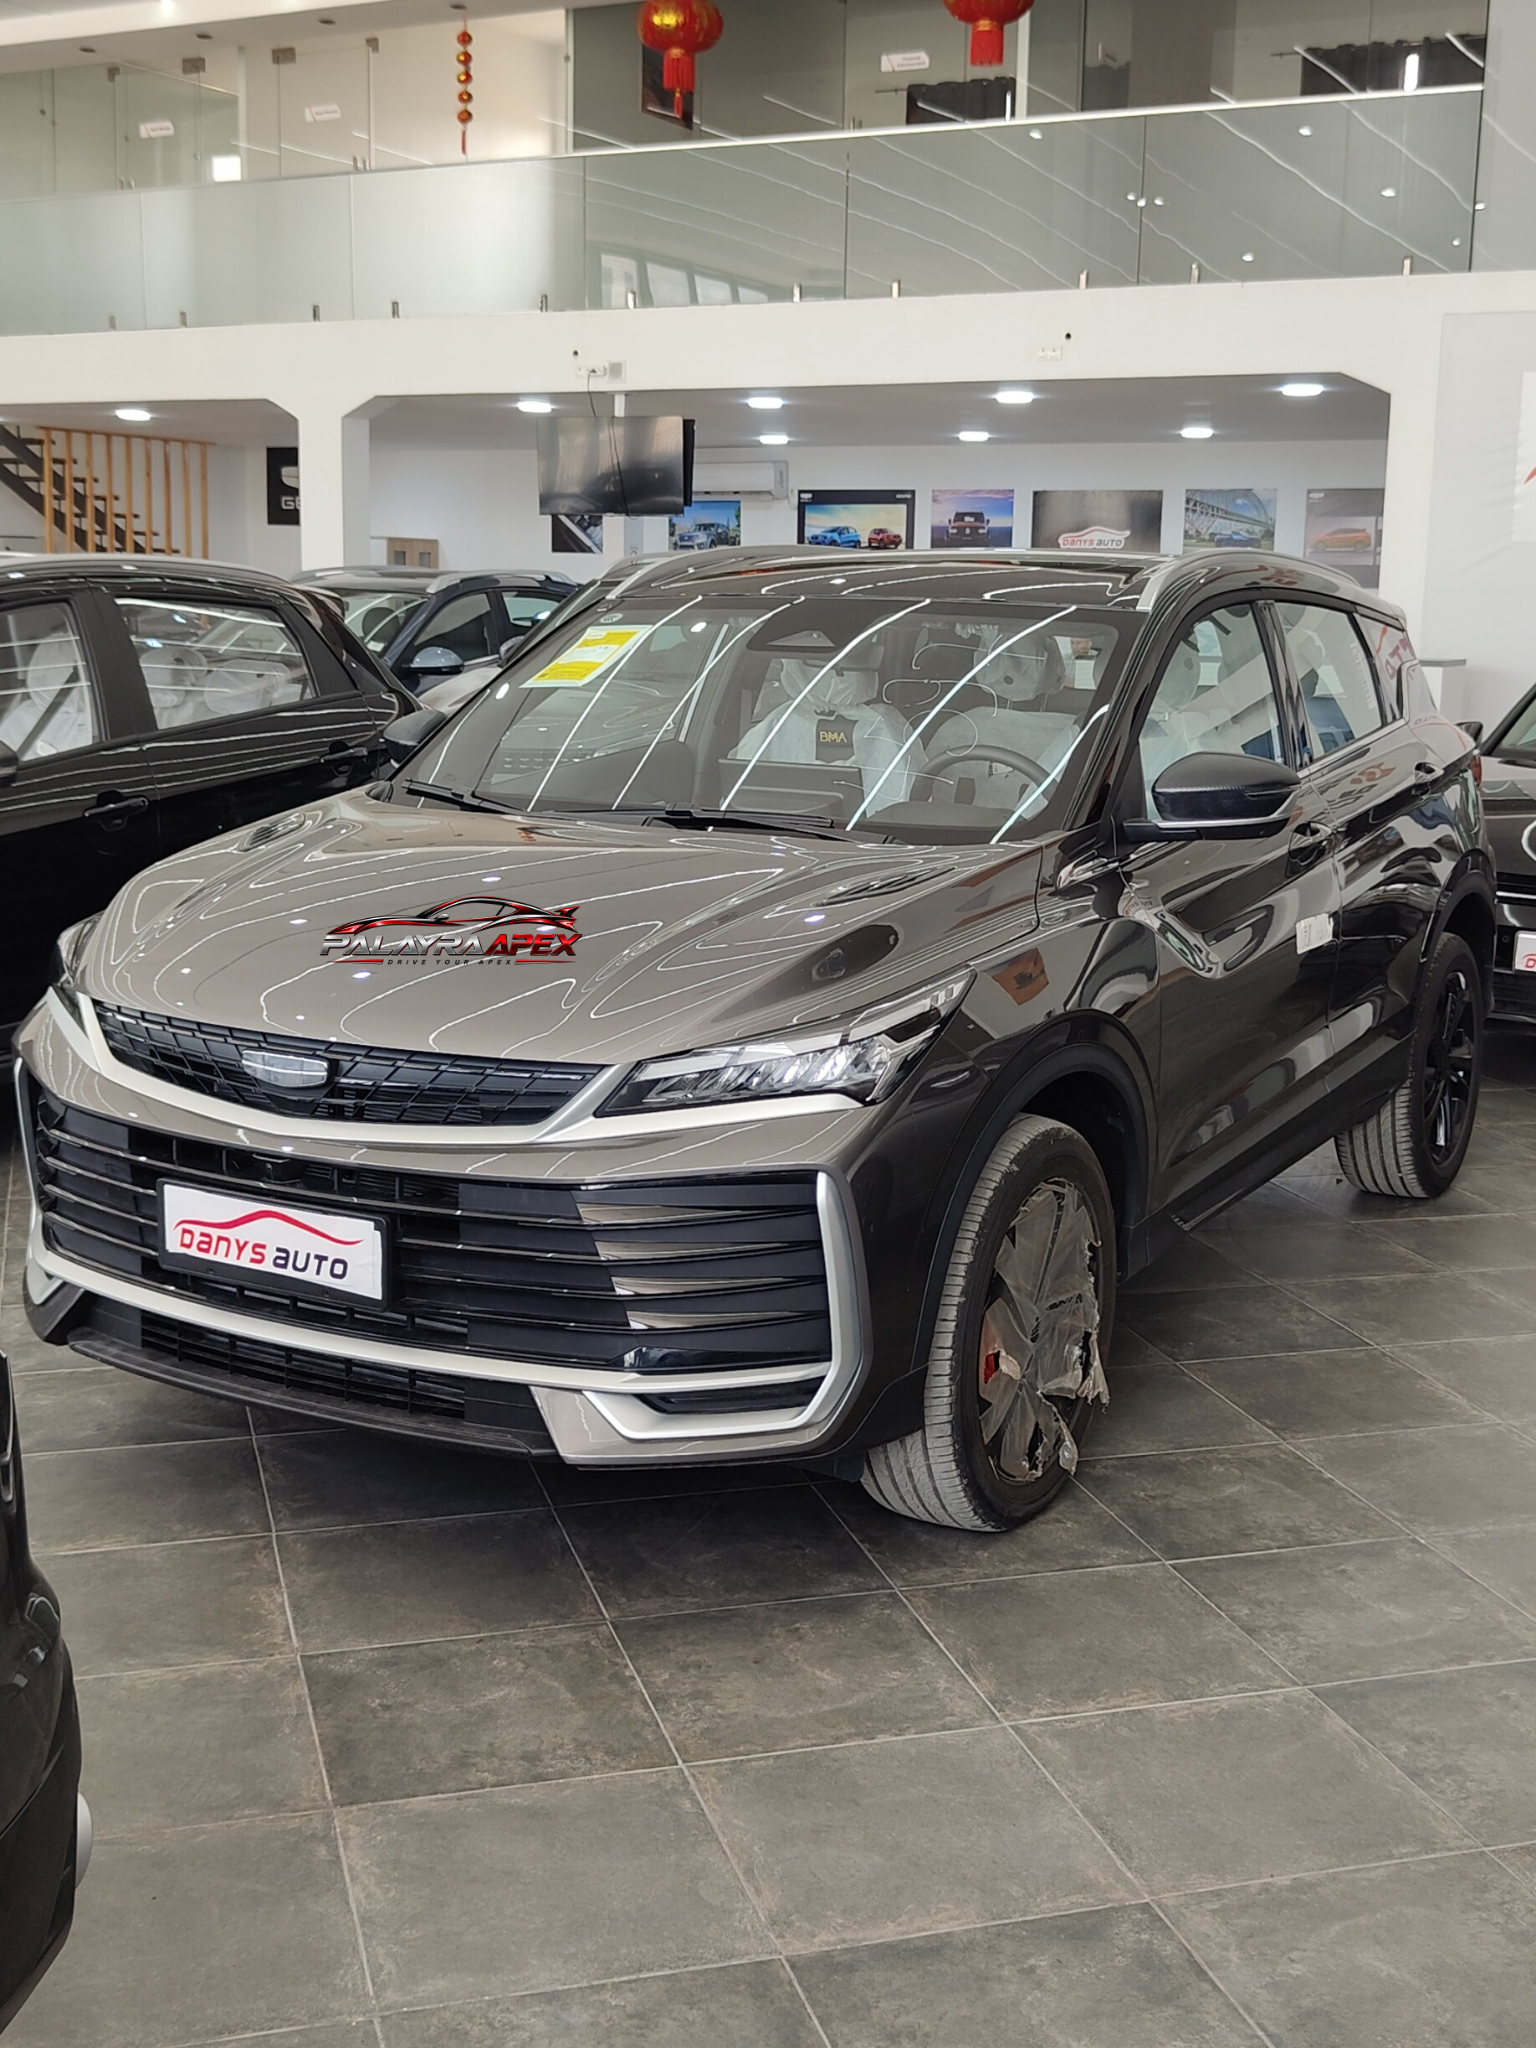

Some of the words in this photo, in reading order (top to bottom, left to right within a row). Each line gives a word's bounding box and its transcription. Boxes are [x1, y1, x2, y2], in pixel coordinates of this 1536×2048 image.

[1062, 539, 1095, 547] DANYS
[1096, 539, 1123, 547] AUTO
[819, 731, 848, 743] BMA
[179, 1227, 267, 1265] DANYS
[272, 1246, 349, 1280] AUTO
